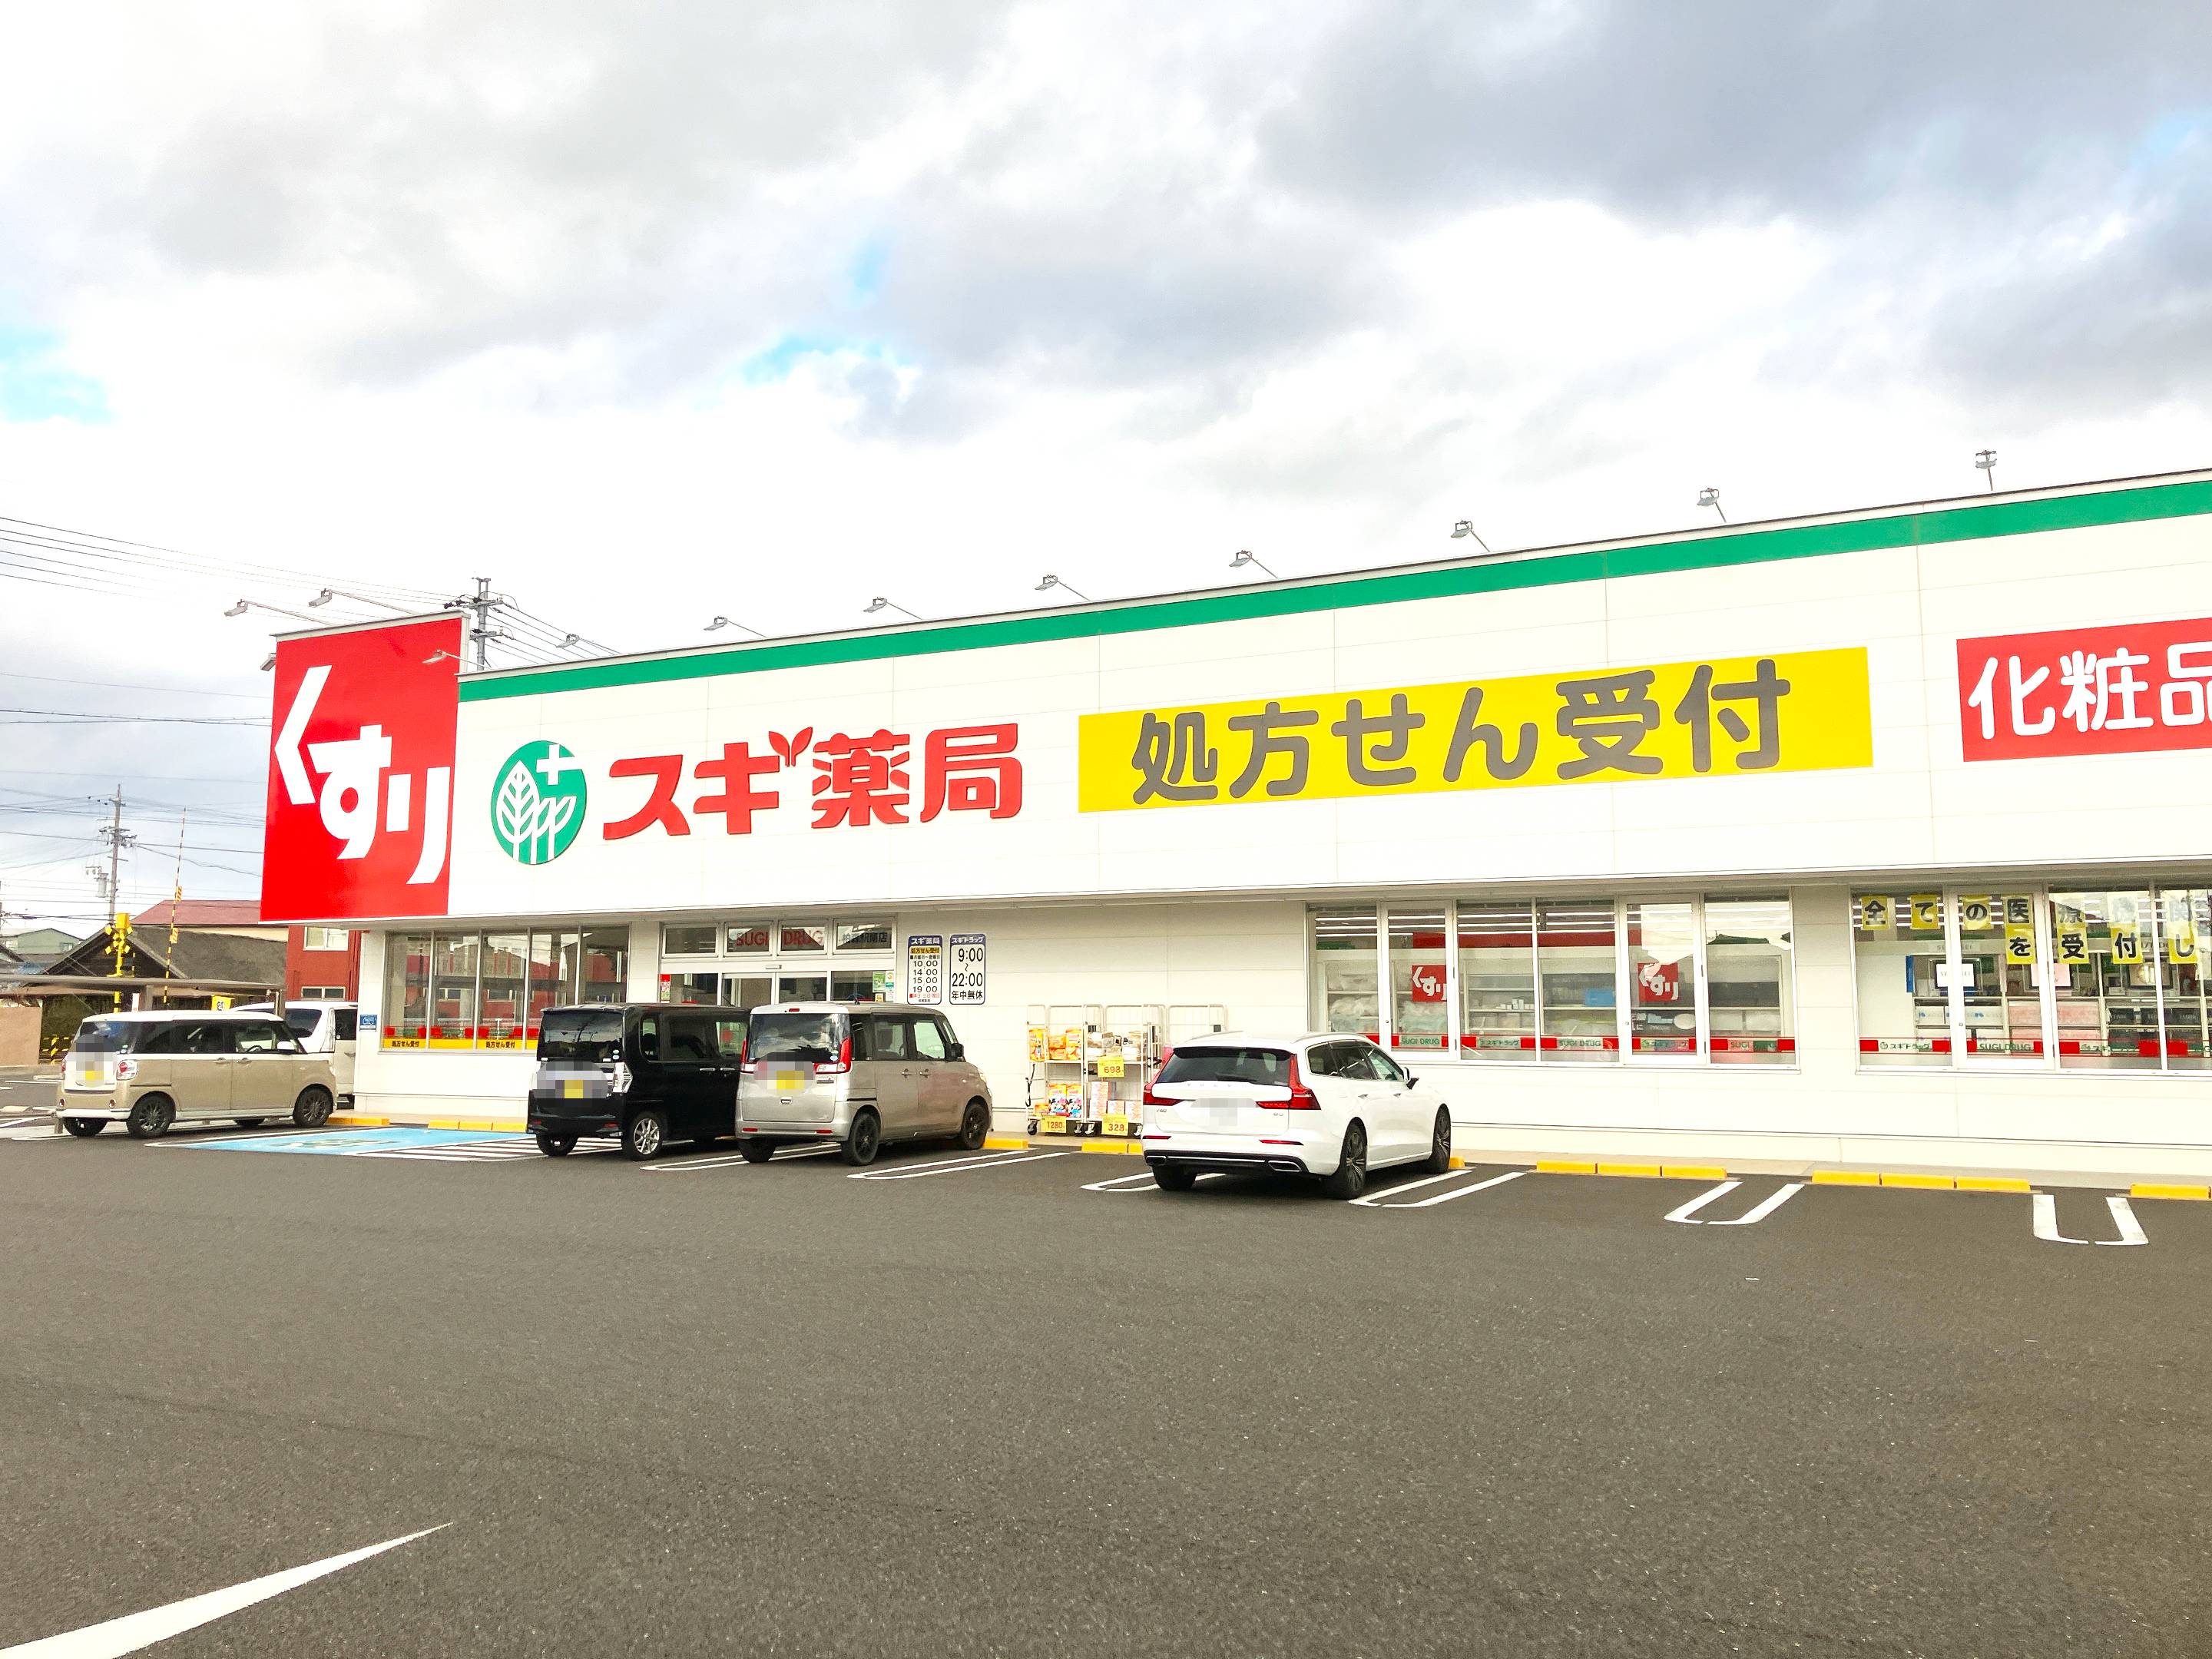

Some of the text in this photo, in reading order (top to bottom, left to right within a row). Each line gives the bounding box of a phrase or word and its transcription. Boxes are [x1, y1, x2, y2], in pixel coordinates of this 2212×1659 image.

[1968, 641, 2212, 740] 化粧品
[1131, 659, 1790, 805] 処方せん受付
[274, 664, 451, 885] くすり
[603, 723, 1022, 840] スギ薬局
[736, 930, 824, 947] SUGI DRUG
[958, 948, 983, 962] 9:00
[952, 972, 983, 987] 22:00
[952, 990, 983, 1000] 年中無休
[1412, 966, 1447, 1001] くすり
[1638, 963, 1679, 1001] くすり
[1401, 1037, 1440, 1045] SUGI DRUG
